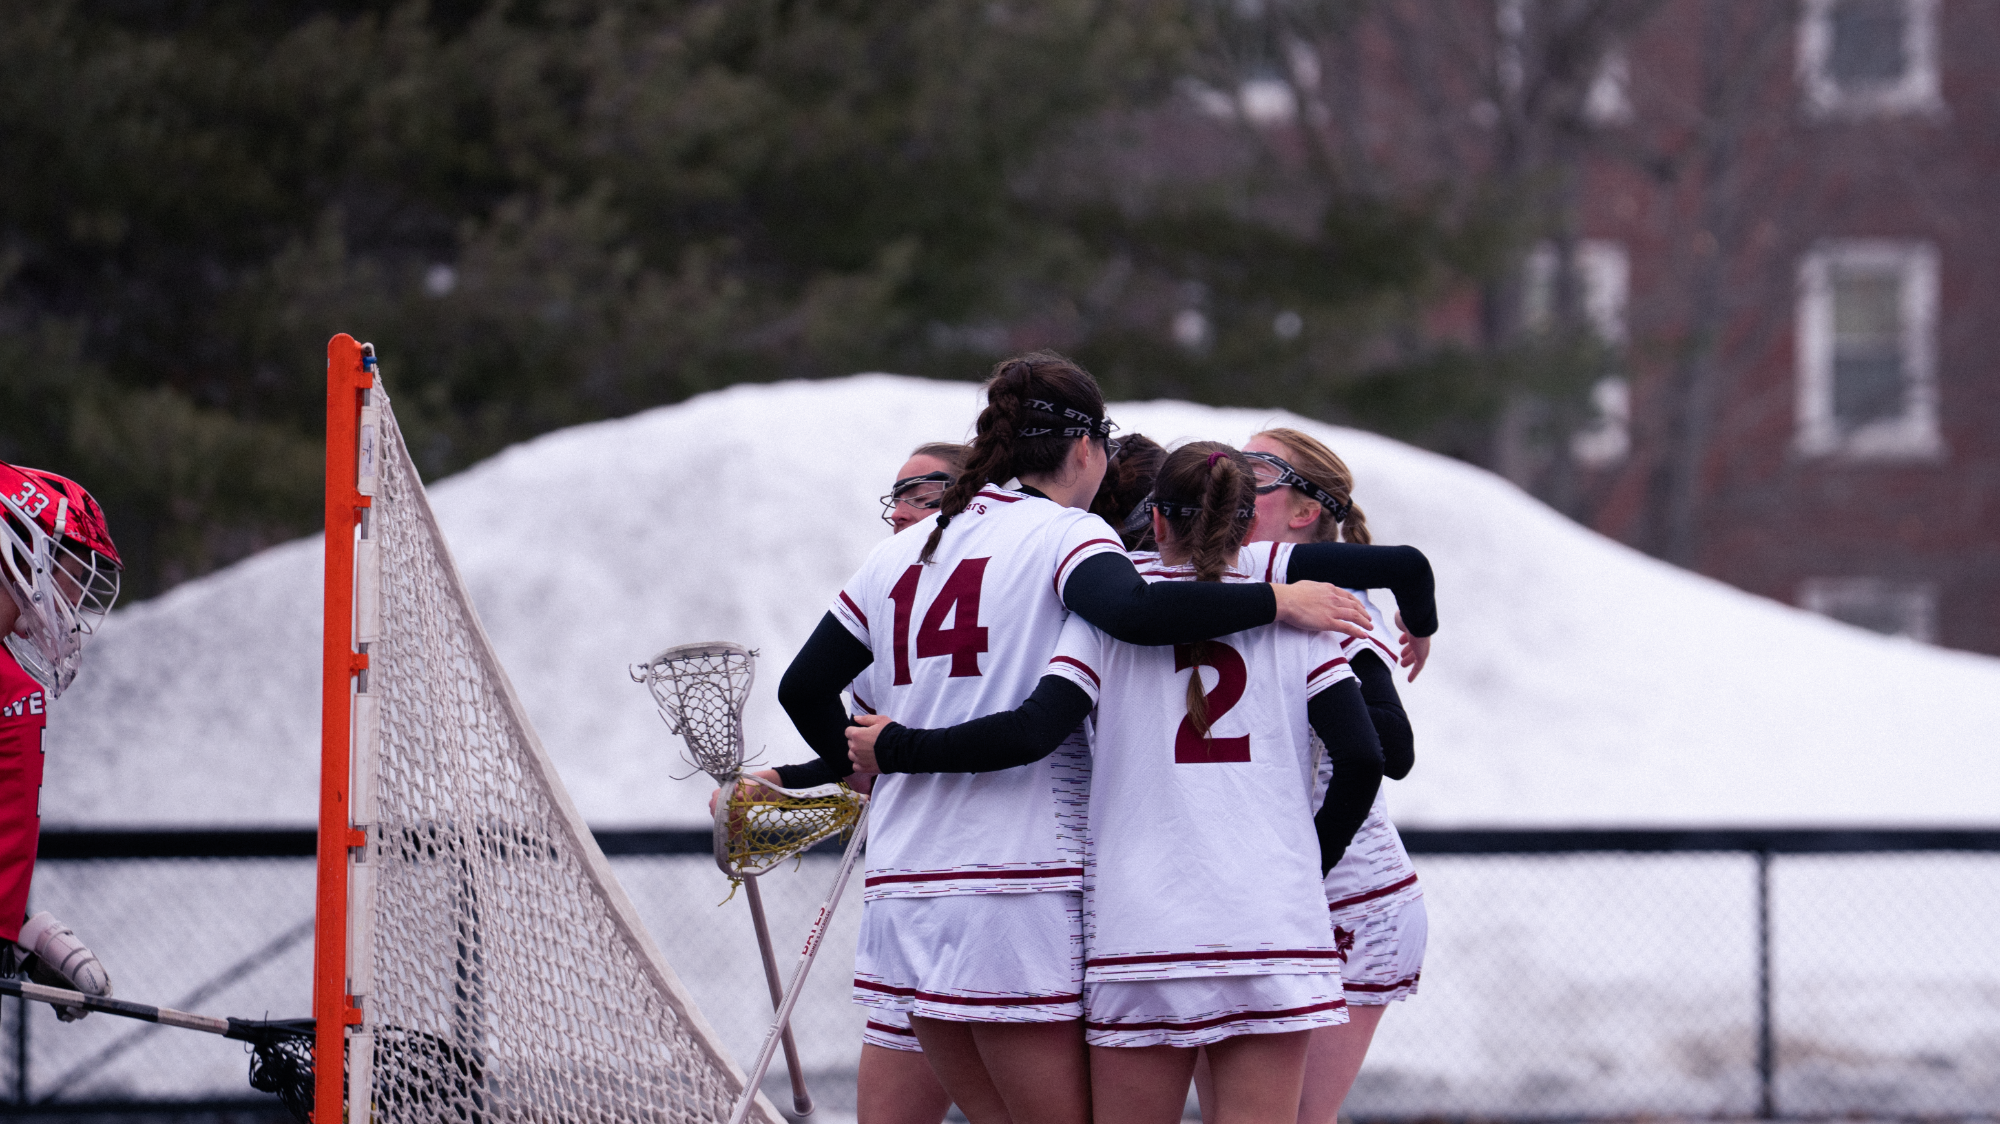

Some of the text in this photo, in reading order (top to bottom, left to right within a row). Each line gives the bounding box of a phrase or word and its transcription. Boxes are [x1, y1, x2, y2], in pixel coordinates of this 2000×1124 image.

[1063, 407, 1093, 426] STX
[1063, 427, 1091, 437] STX
[10, 481, 50, 518] 33
[1314, 490, 1340, 511] STX
[888, 555, 992, 686] 14
[1173, 640, 1251, 764] 2
